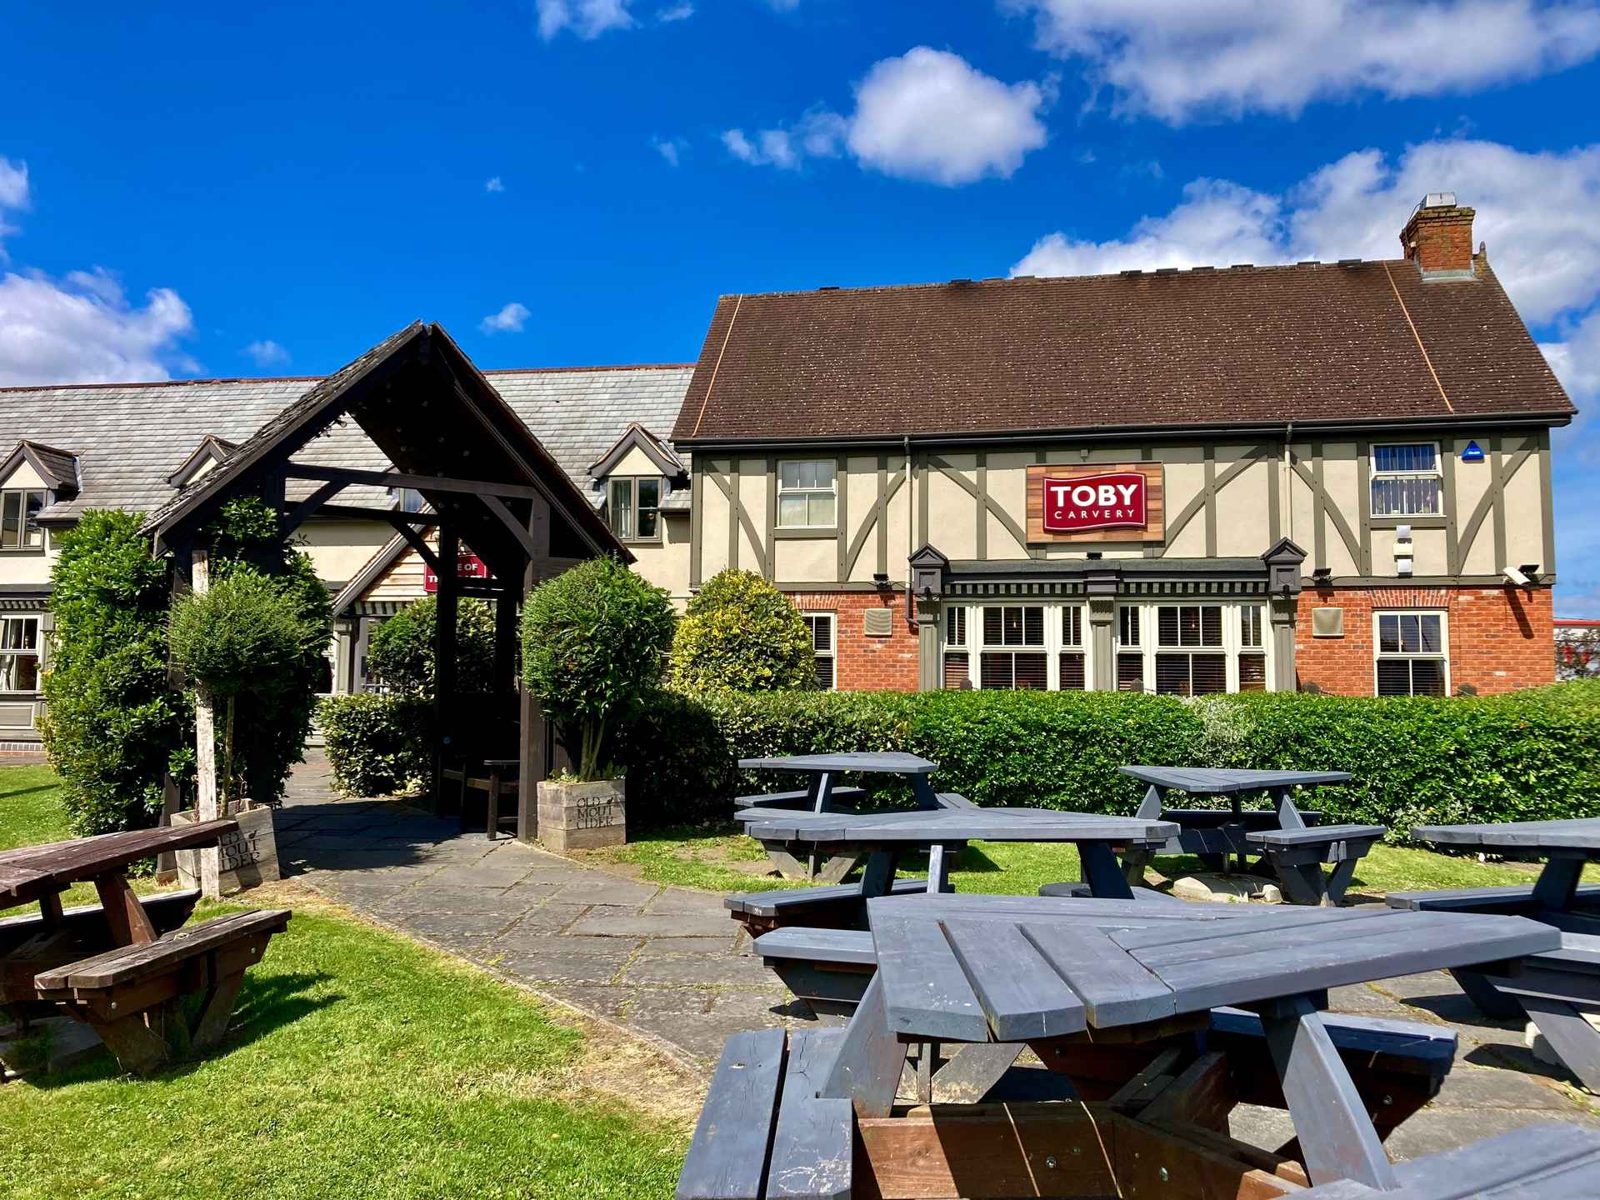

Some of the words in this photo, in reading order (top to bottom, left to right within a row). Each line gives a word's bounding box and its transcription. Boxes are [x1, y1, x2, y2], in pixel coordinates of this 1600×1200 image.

[1050, 484, 1138, 507] TOBY
[1054, 509, 1134, 519] CARVERY
[464, 563, 478, 571] OF
[577, 797, 600, 808] OLD
[577, 805, 613, 819] MOUT
[577, 815, 613, 830] CIDER
[220, 831, 240, 846] LD
[219, 851, 261, 874] IDER
